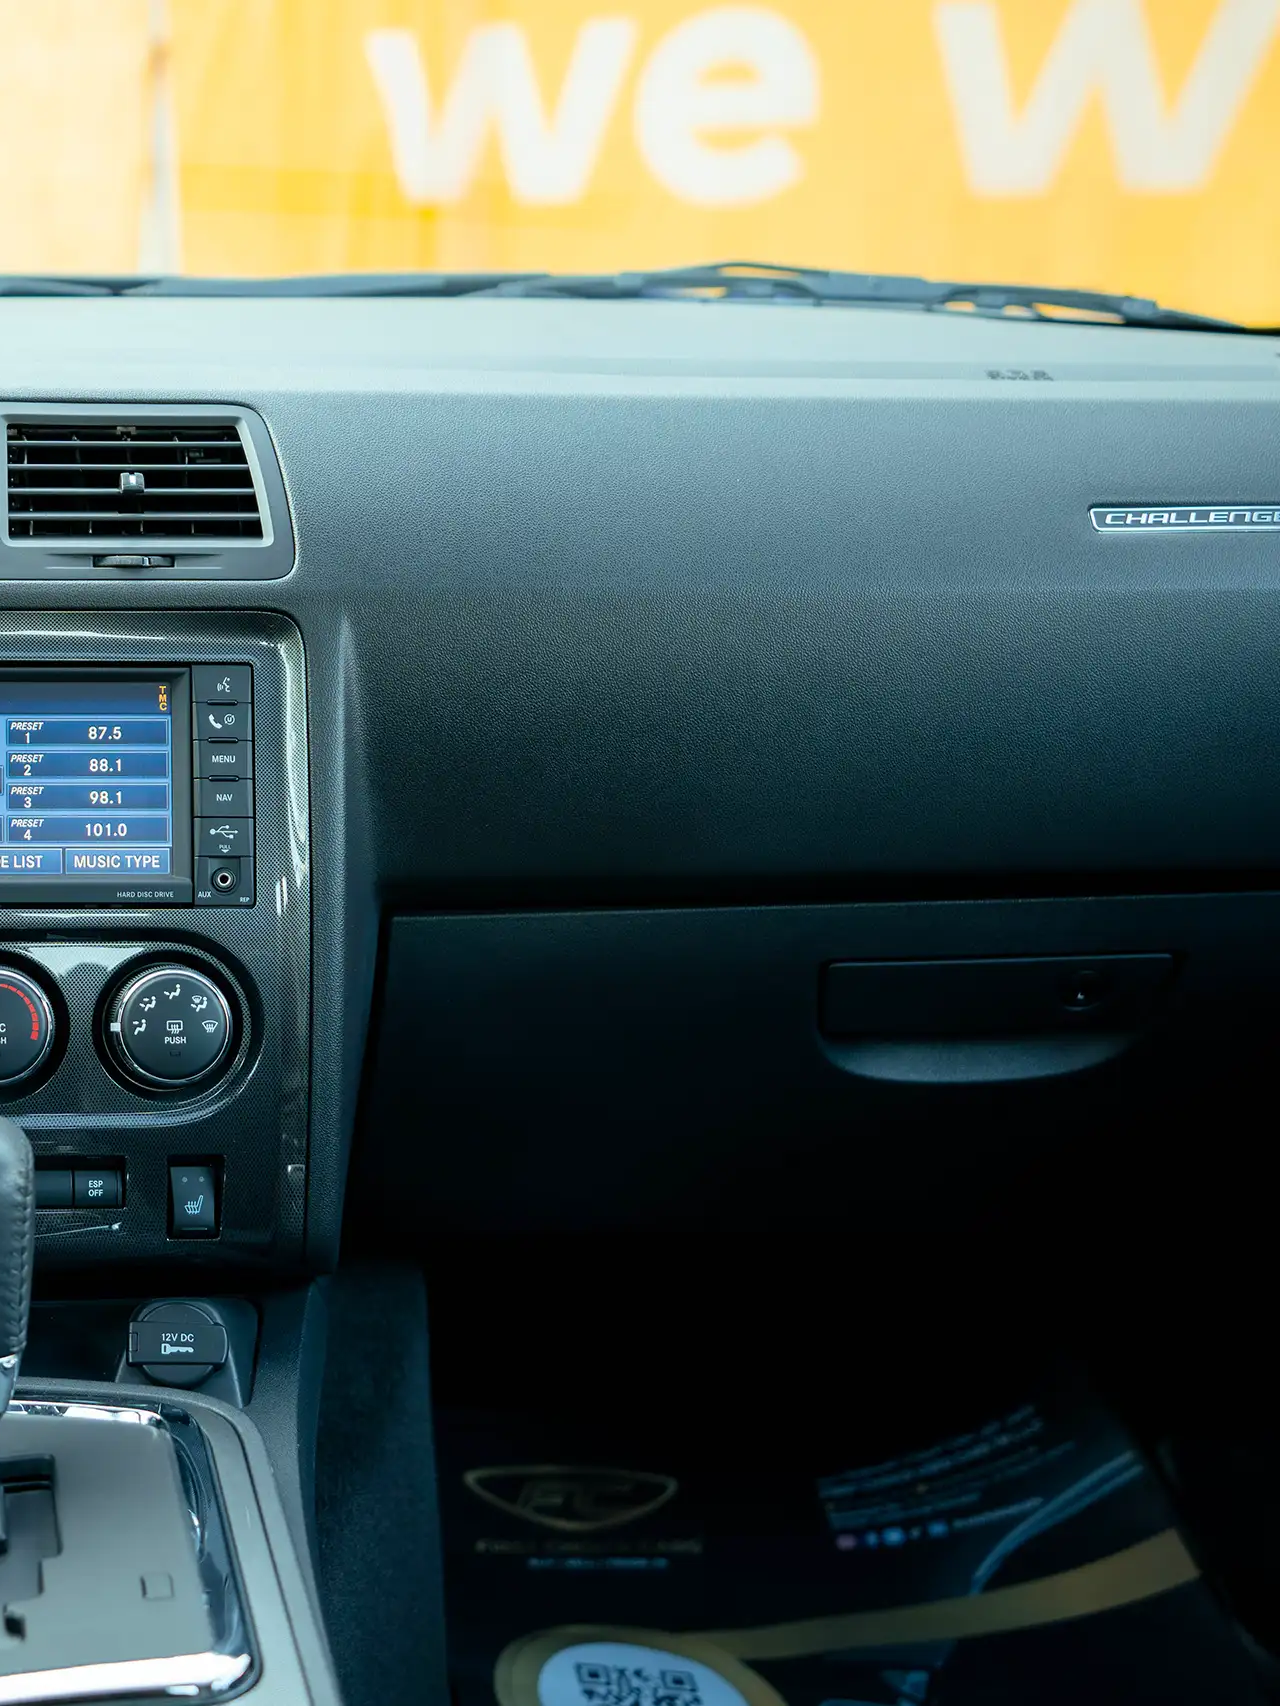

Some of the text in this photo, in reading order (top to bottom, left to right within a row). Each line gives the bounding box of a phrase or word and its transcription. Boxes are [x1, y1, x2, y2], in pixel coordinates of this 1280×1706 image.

[363, 5, 820, 206] we
[10, 721, 44, 731] PRESET
[24, 732, 31, 744] 1
[88, 726, 122, 740] 87.5
[10, 754, 44, 763] PRESET
[211, 755, 236, 763] MENU
[24, 765, 32, 776] 2
[89, 759, 123, 772] 88.1
[10, 786, 44, 796] PRESET
[24, 797, 32, 809] 3
[89, 791, 123, 805] 98.1
[216, 793, 233, 802] NAV
[10, 818, 44, 828] PRESET
[23, 829, 32, 841] 4
[85, 823, 128, 837] 101.0
[13, 855, 43, 868] LIST
[74, 855, 161, 868] MUSIC TYPE
[164, 1036, 186, 1044] PUSH
[88, 1180, 103, 1188] ESP
[88, 1189, 103, 1197] OFF
[161, 1333, 194, 1342] 12V DC
